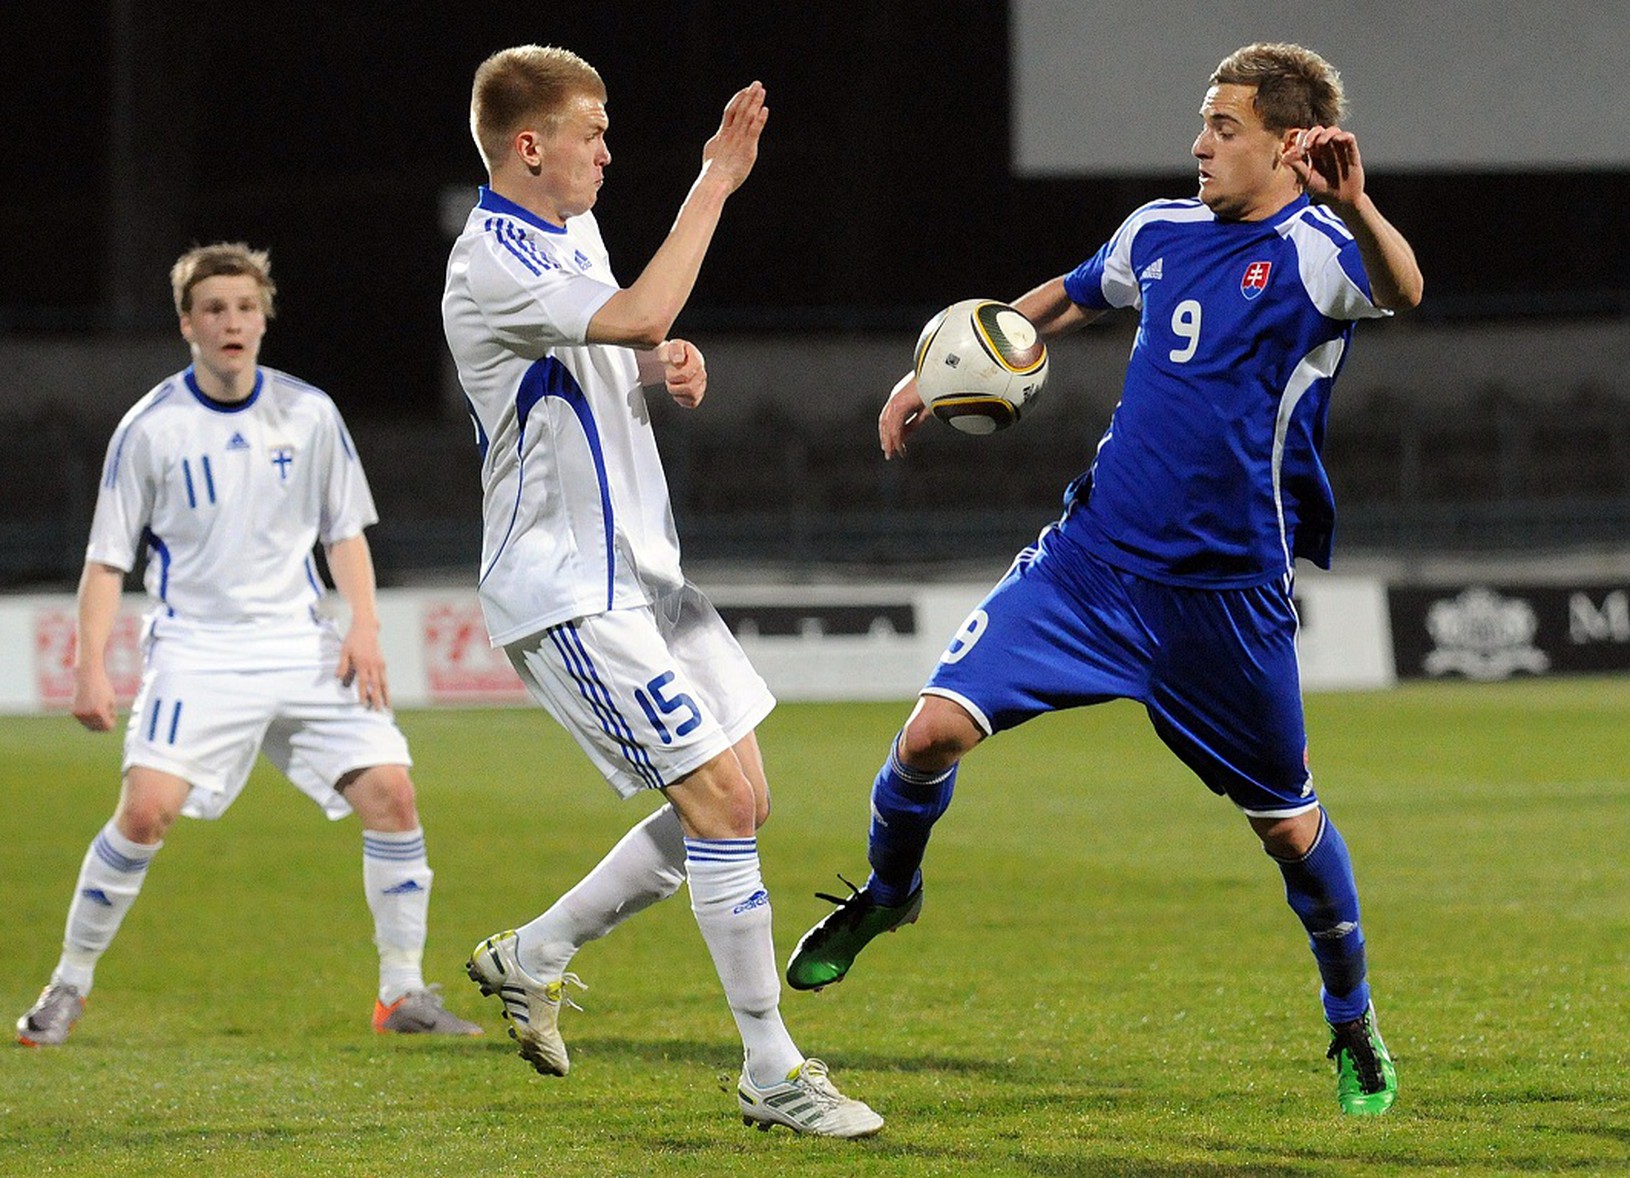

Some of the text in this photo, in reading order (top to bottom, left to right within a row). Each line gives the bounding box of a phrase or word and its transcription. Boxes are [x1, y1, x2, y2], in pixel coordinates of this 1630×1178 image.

[1169, 299, 1202, 363] 9
[183, 456, 216, 508] 11
[940, 609, 989, 664] 9
[149, 699, 182, 745] 11
[634, 670, 702, 745] 15
